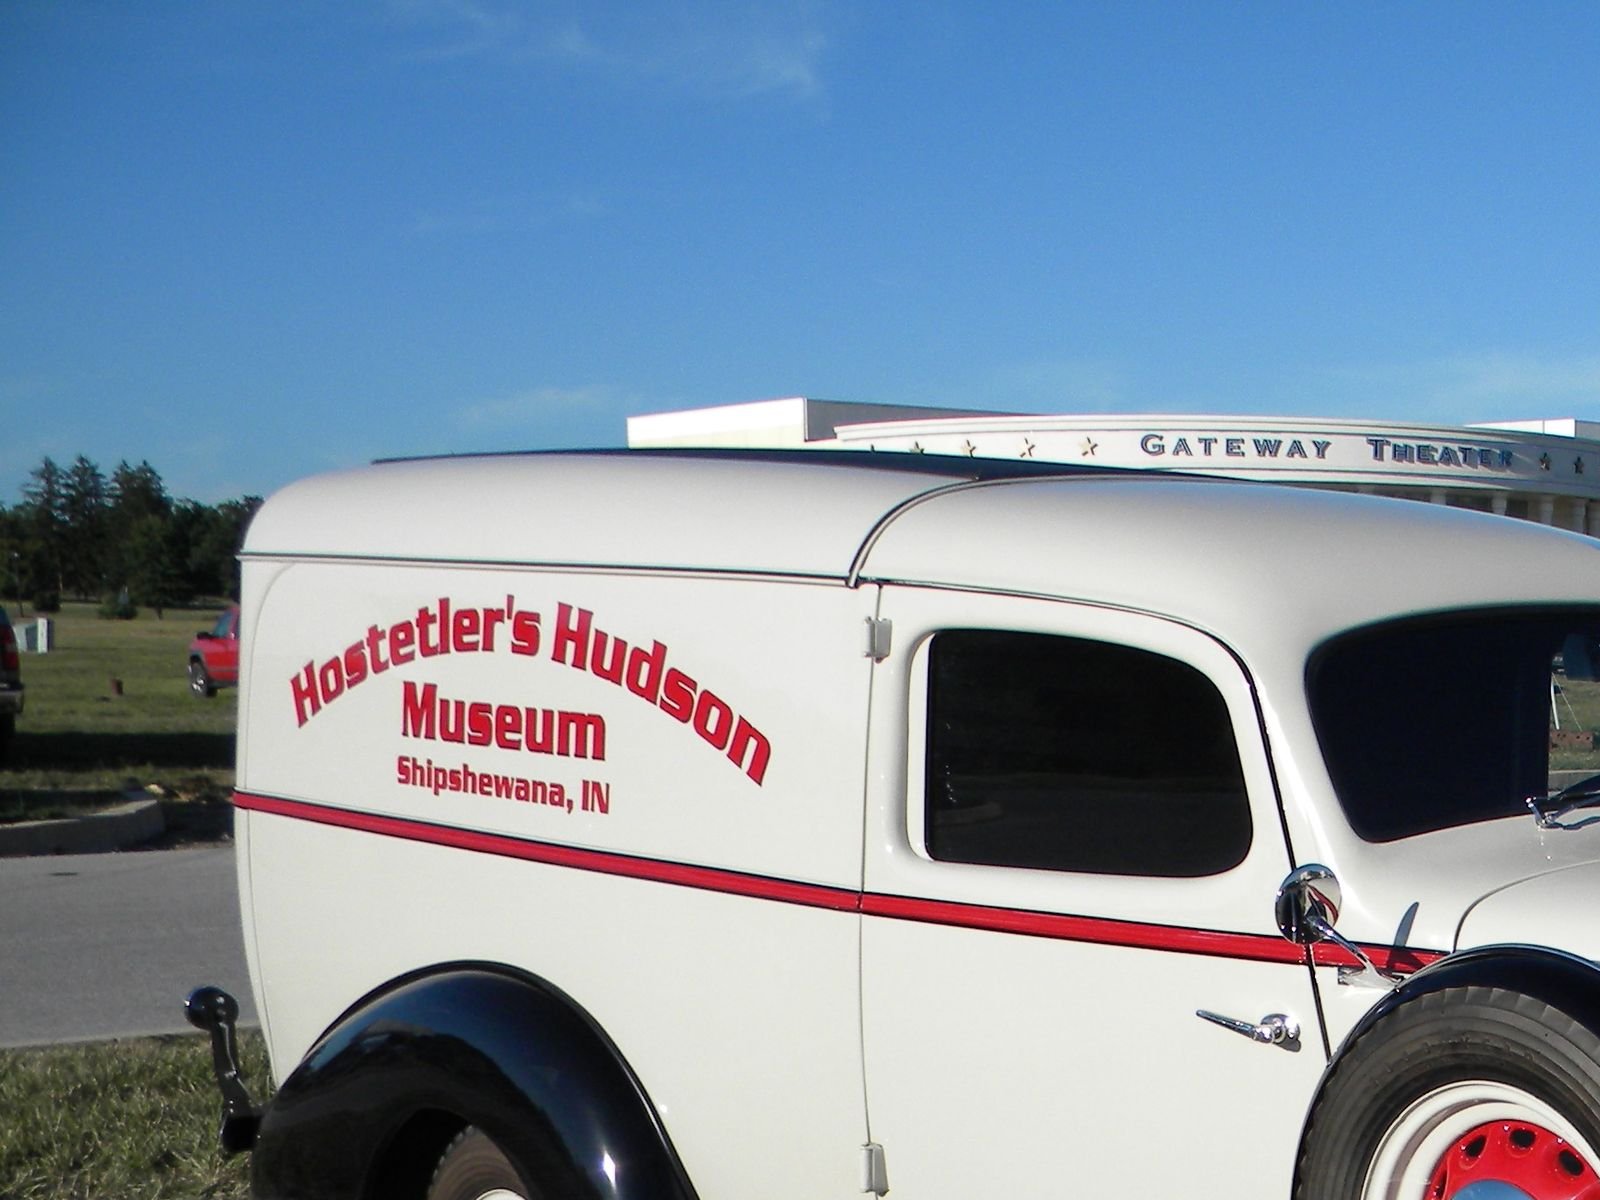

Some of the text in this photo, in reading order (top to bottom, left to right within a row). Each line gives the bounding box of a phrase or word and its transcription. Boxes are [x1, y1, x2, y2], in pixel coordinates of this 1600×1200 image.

[1140, 434, 1513, 467] GATEWAY THEATER
[289, 594, 772, 788] Hostetler's Hudson
[401, 681, 606, 762] Museum
[396, 756, 611, 815] Shipshewana, IN
